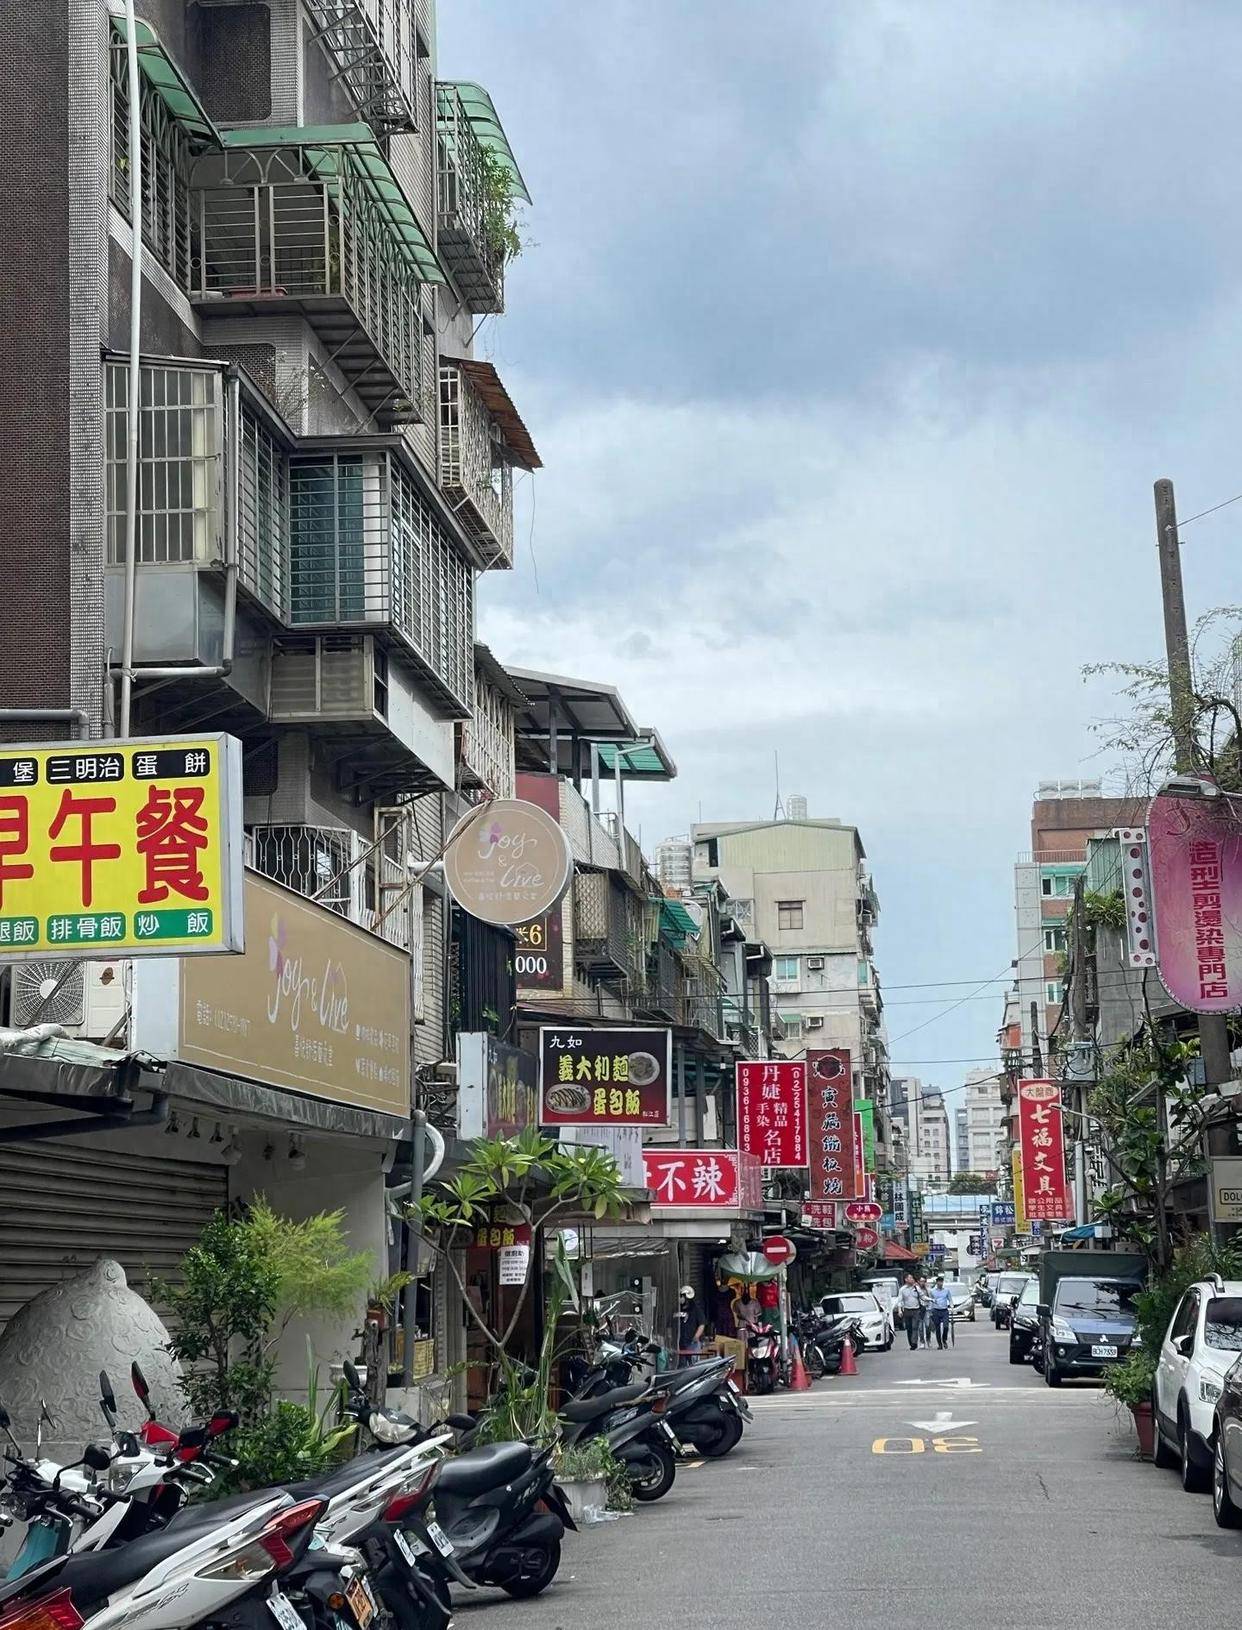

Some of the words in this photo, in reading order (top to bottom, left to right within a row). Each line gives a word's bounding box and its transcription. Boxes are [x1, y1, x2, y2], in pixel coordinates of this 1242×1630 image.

[50, 757, 120, 780] 三明治
[136, 752, 206, 776] 蛋餅
[51, 917, 122, 940] 排骨飯
[138, 913, 209, 936] 炒飯
[550, 1035, 583, 1049] 九如
[558, 1055, 629, 1082] 義大利麵
[761, 1065, 781, 1100] 丹婕
[593, 1088, 641, 1116] 蛋包飯
[755, 1102, 770, 1127] 手染
[773, 1102, 788, 1127] 精品
[763, 1129, 782, 1164] 名店
[1029, 1103, 1056, 1196] 七福文具
[643, 1157, 727, 1202] 不辣
[1224, 1192, 1242, 1201] DOL
